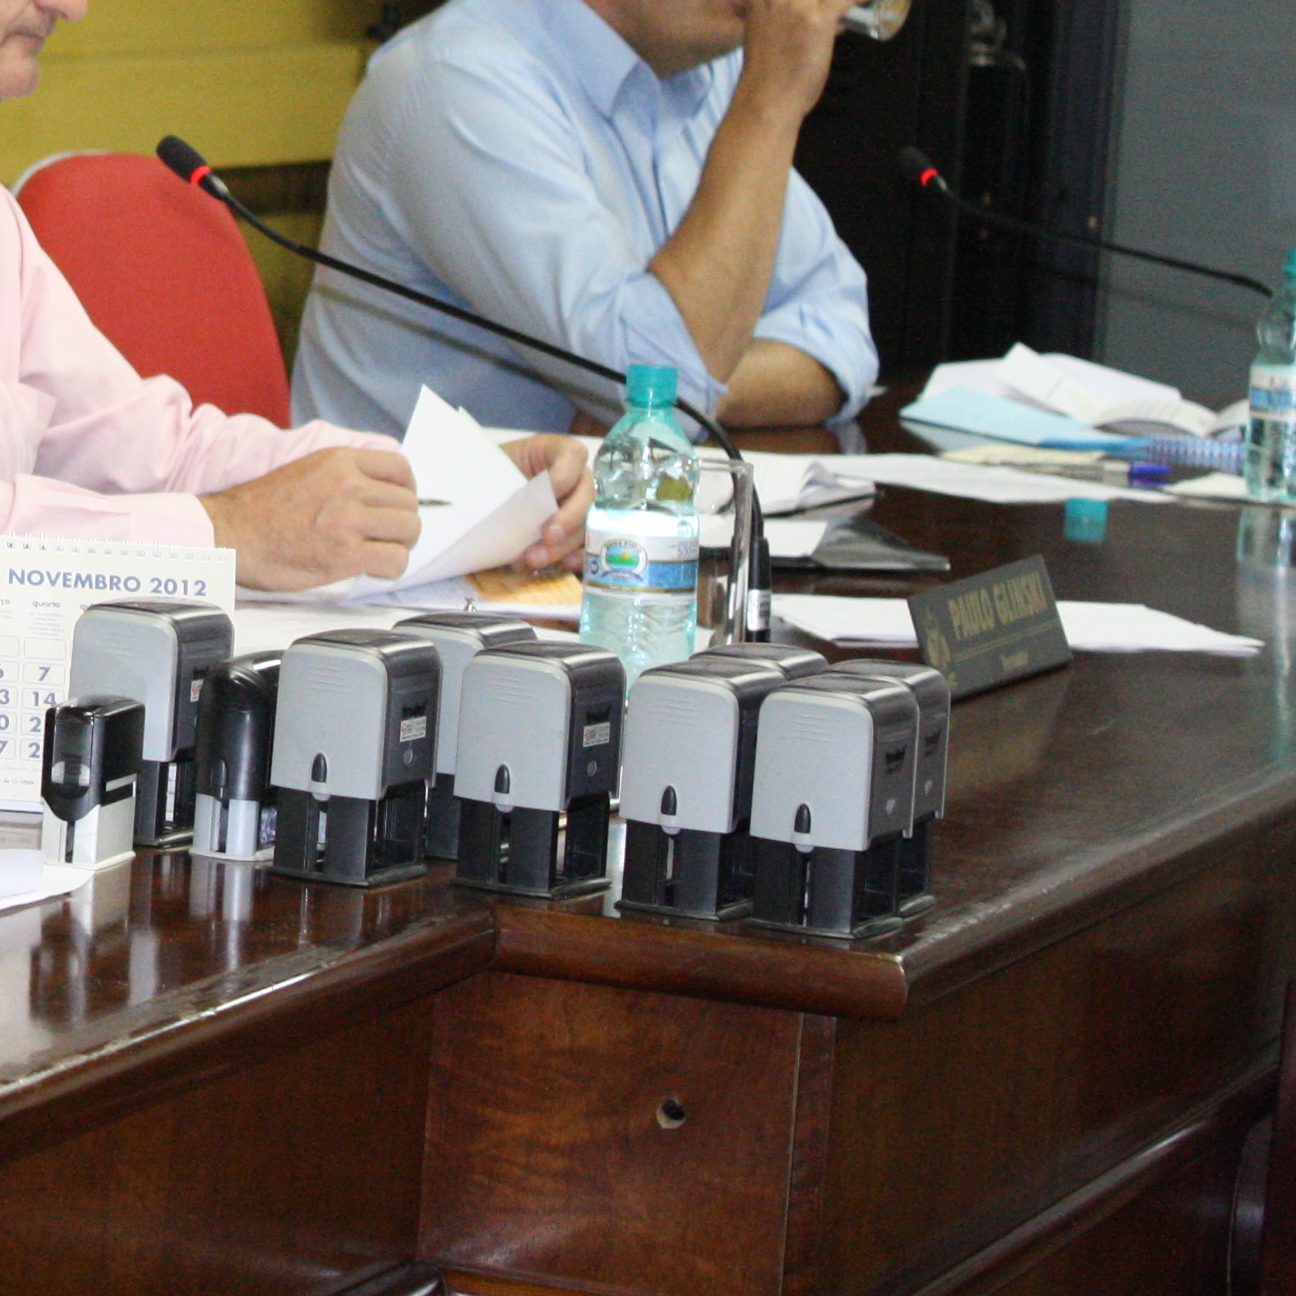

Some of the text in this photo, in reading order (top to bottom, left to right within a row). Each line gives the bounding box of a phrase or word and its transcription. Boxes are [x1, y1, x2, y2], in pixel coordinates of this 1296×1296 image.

[7, 568, 208, 597] NOVEMBRO 2012
[38, 666, 52, 682] 7
[32, 690, 58, 707] 14
[28, 715, 42, 733] 2
[27, 741, 41, 759] 2
